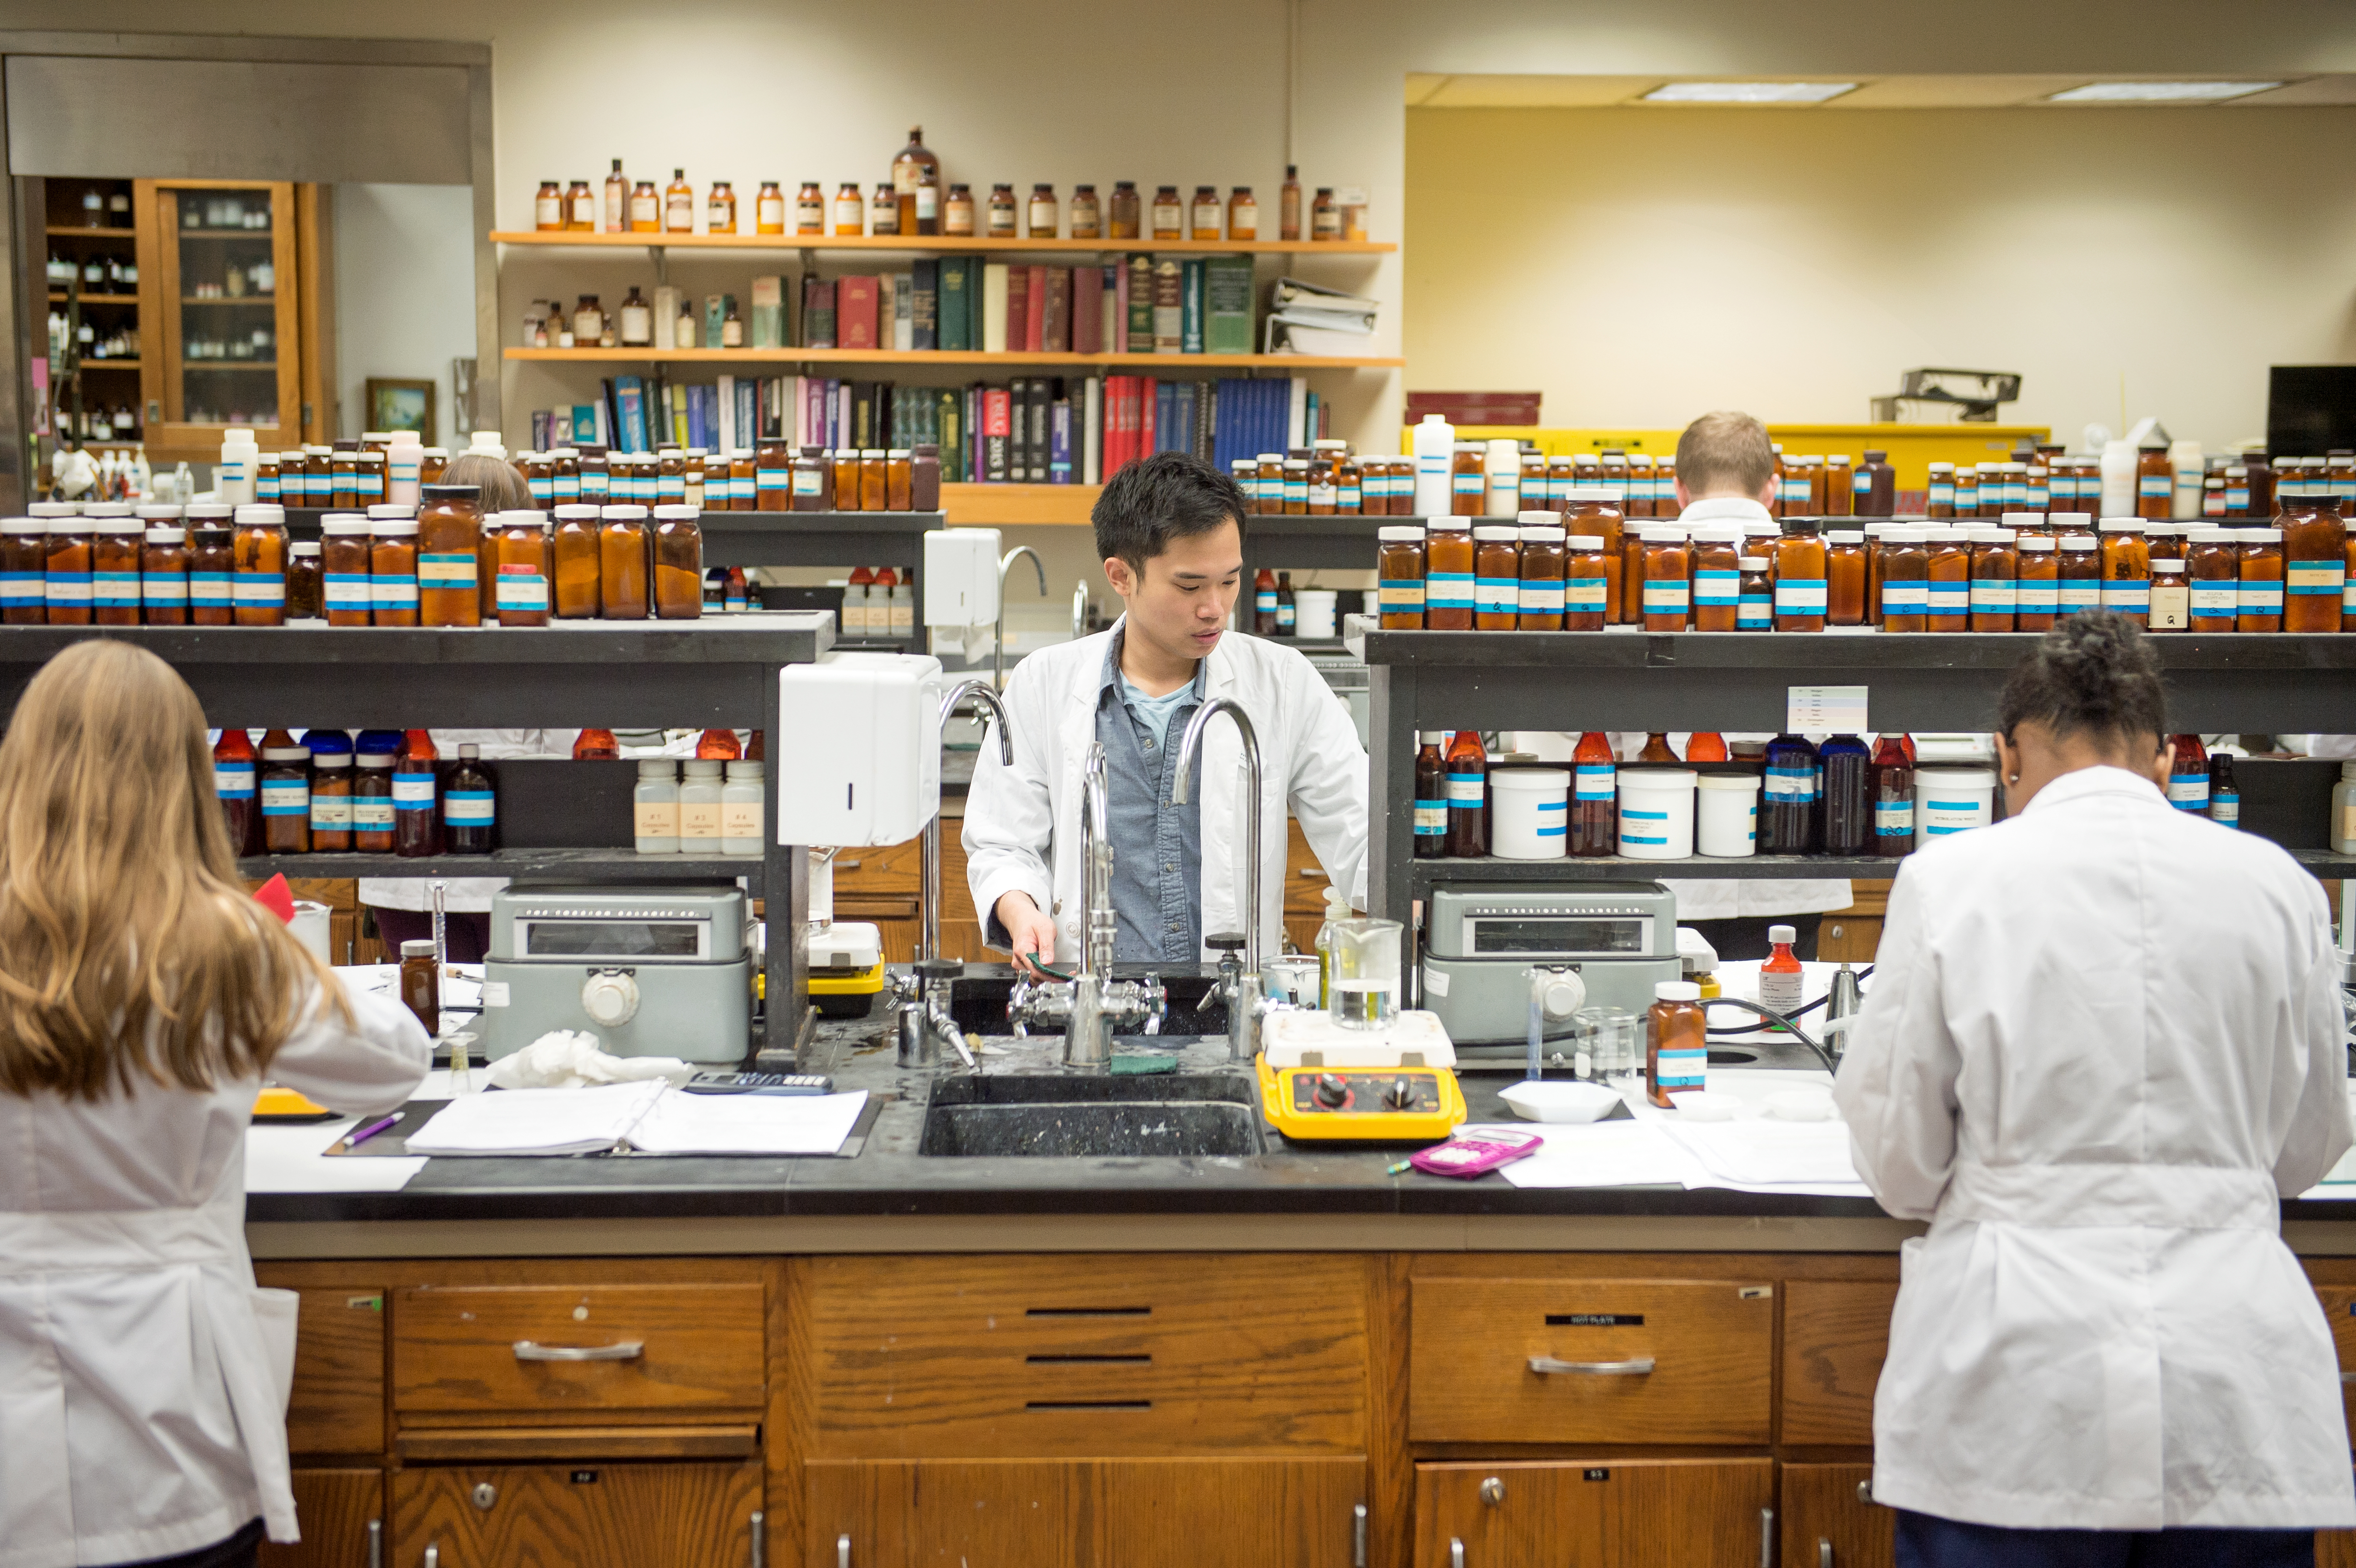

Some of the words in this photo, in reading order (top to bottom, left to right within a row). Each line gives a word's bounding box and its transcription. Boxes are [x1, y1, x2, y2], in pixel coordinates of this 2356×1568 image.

[1493, 601, 1503, 612] Q
[2256, 606, 2264, 614] Q
[2167, 615, 2175, 625] Q
[1679, 1077, 1690, 1086] Q
[1571, 1316, 1588, 1324] HOT
[1590, 1316, 1615, 1324] PLATE
